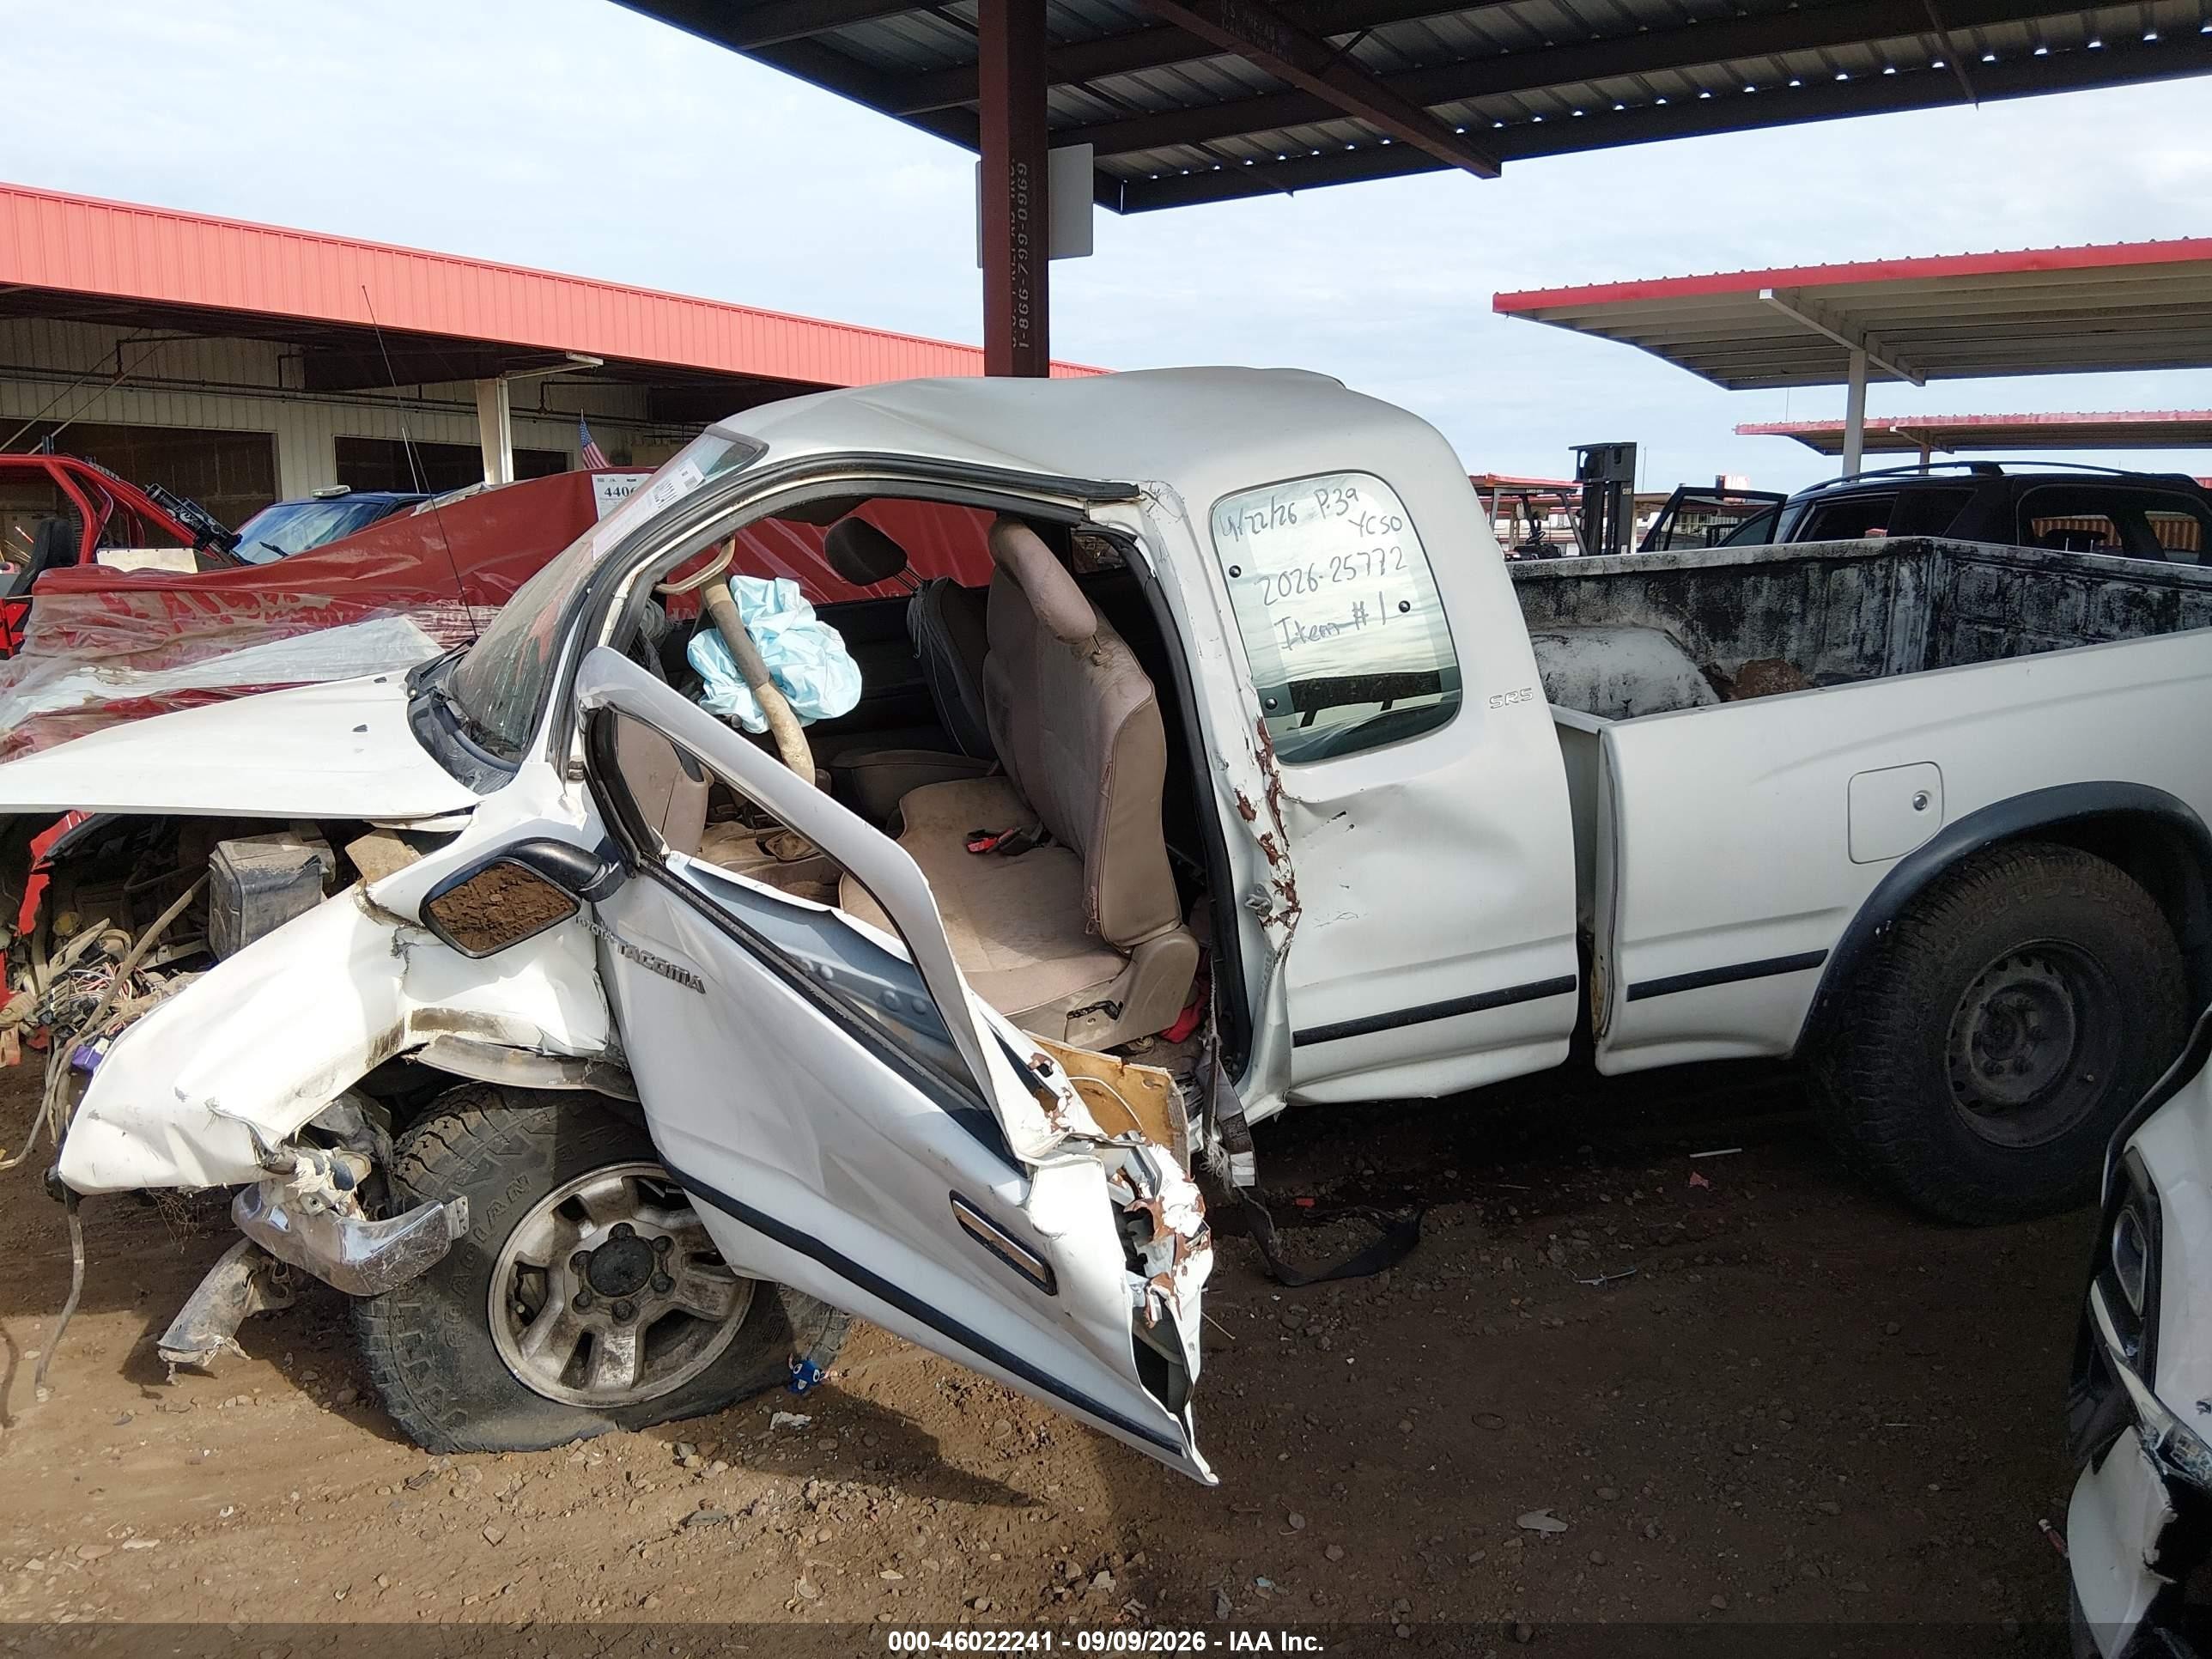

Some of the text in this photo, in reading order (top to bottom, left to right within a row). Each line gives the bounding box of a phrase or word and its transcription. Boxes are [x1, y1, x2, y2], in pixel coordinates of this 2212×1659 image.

[1018, 162, 1030, 349] 1-866-799-0969
[1347, 510, 1402, 538] YCSO
[1273, 616, 1340, 651] Item
[614, 940, 707, 994] TACOMA
